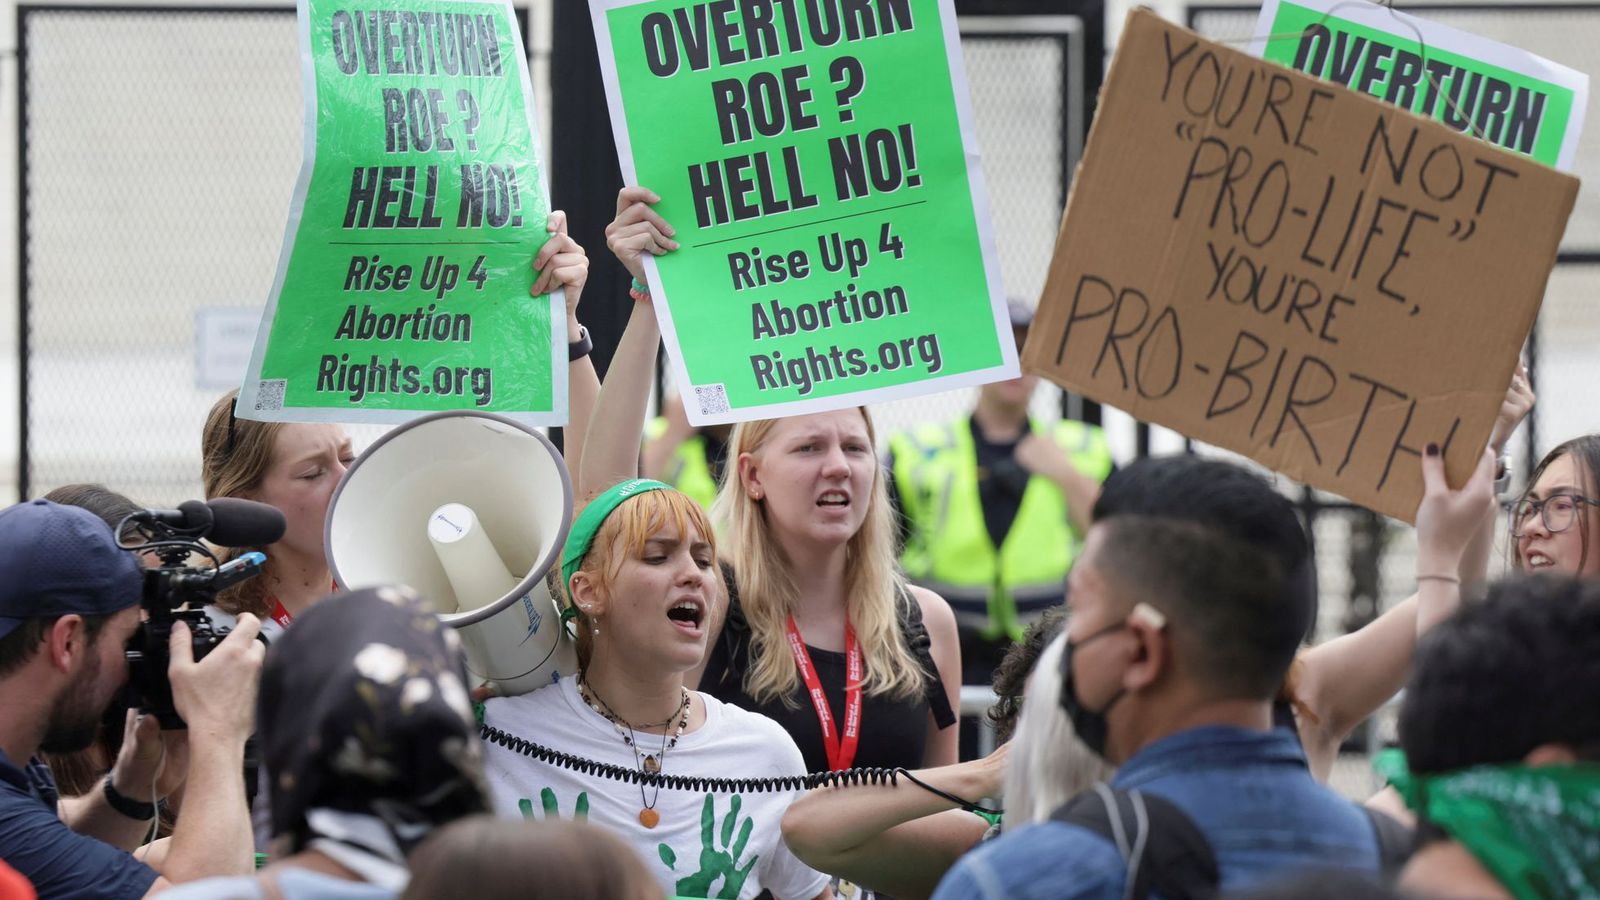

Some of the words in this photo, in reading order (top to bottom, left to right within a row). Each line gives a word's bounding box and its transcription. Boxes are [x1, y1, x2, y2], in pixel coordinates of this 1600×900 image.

[332, 9, 502, 77] OVERTURN
[381, 87, 455, 153] ROE
[457, 88, 480, 152] ?
[711, 64, 819, 146] ROE
[829, 55, 865, 123] ?
[1162, 31, 1334, 155] YOU'RE
[1361, 116, 1519, 216] NOT
[1292, 22, 1548, 157] OVERTURN
[343, 166, 443, 229] HELL
[456, 163, 523, 229] NO!
[688, 145, 818, 229] HELL
[828, 123, 921, 201] NO!
[344, 255, 412, 293] Rise
[420, 255, 459, 299] Up
[467, 255, 487, 291] 4
[728, 246, 809, 291] Rise
[818, 231, 869, 279] Up
[878, 222, 904, 260] 4
[334, 304, 472, 342] Abortion
[751, 283, 909, 341] Abortion
[1207, 242, 1355, 345] YOU'RE
[317, 354, 492, 406] Rights.org
[750, 333, 942, 395] Rights.org
[1056, 274, 1460, 493] PRO-BIRTH
